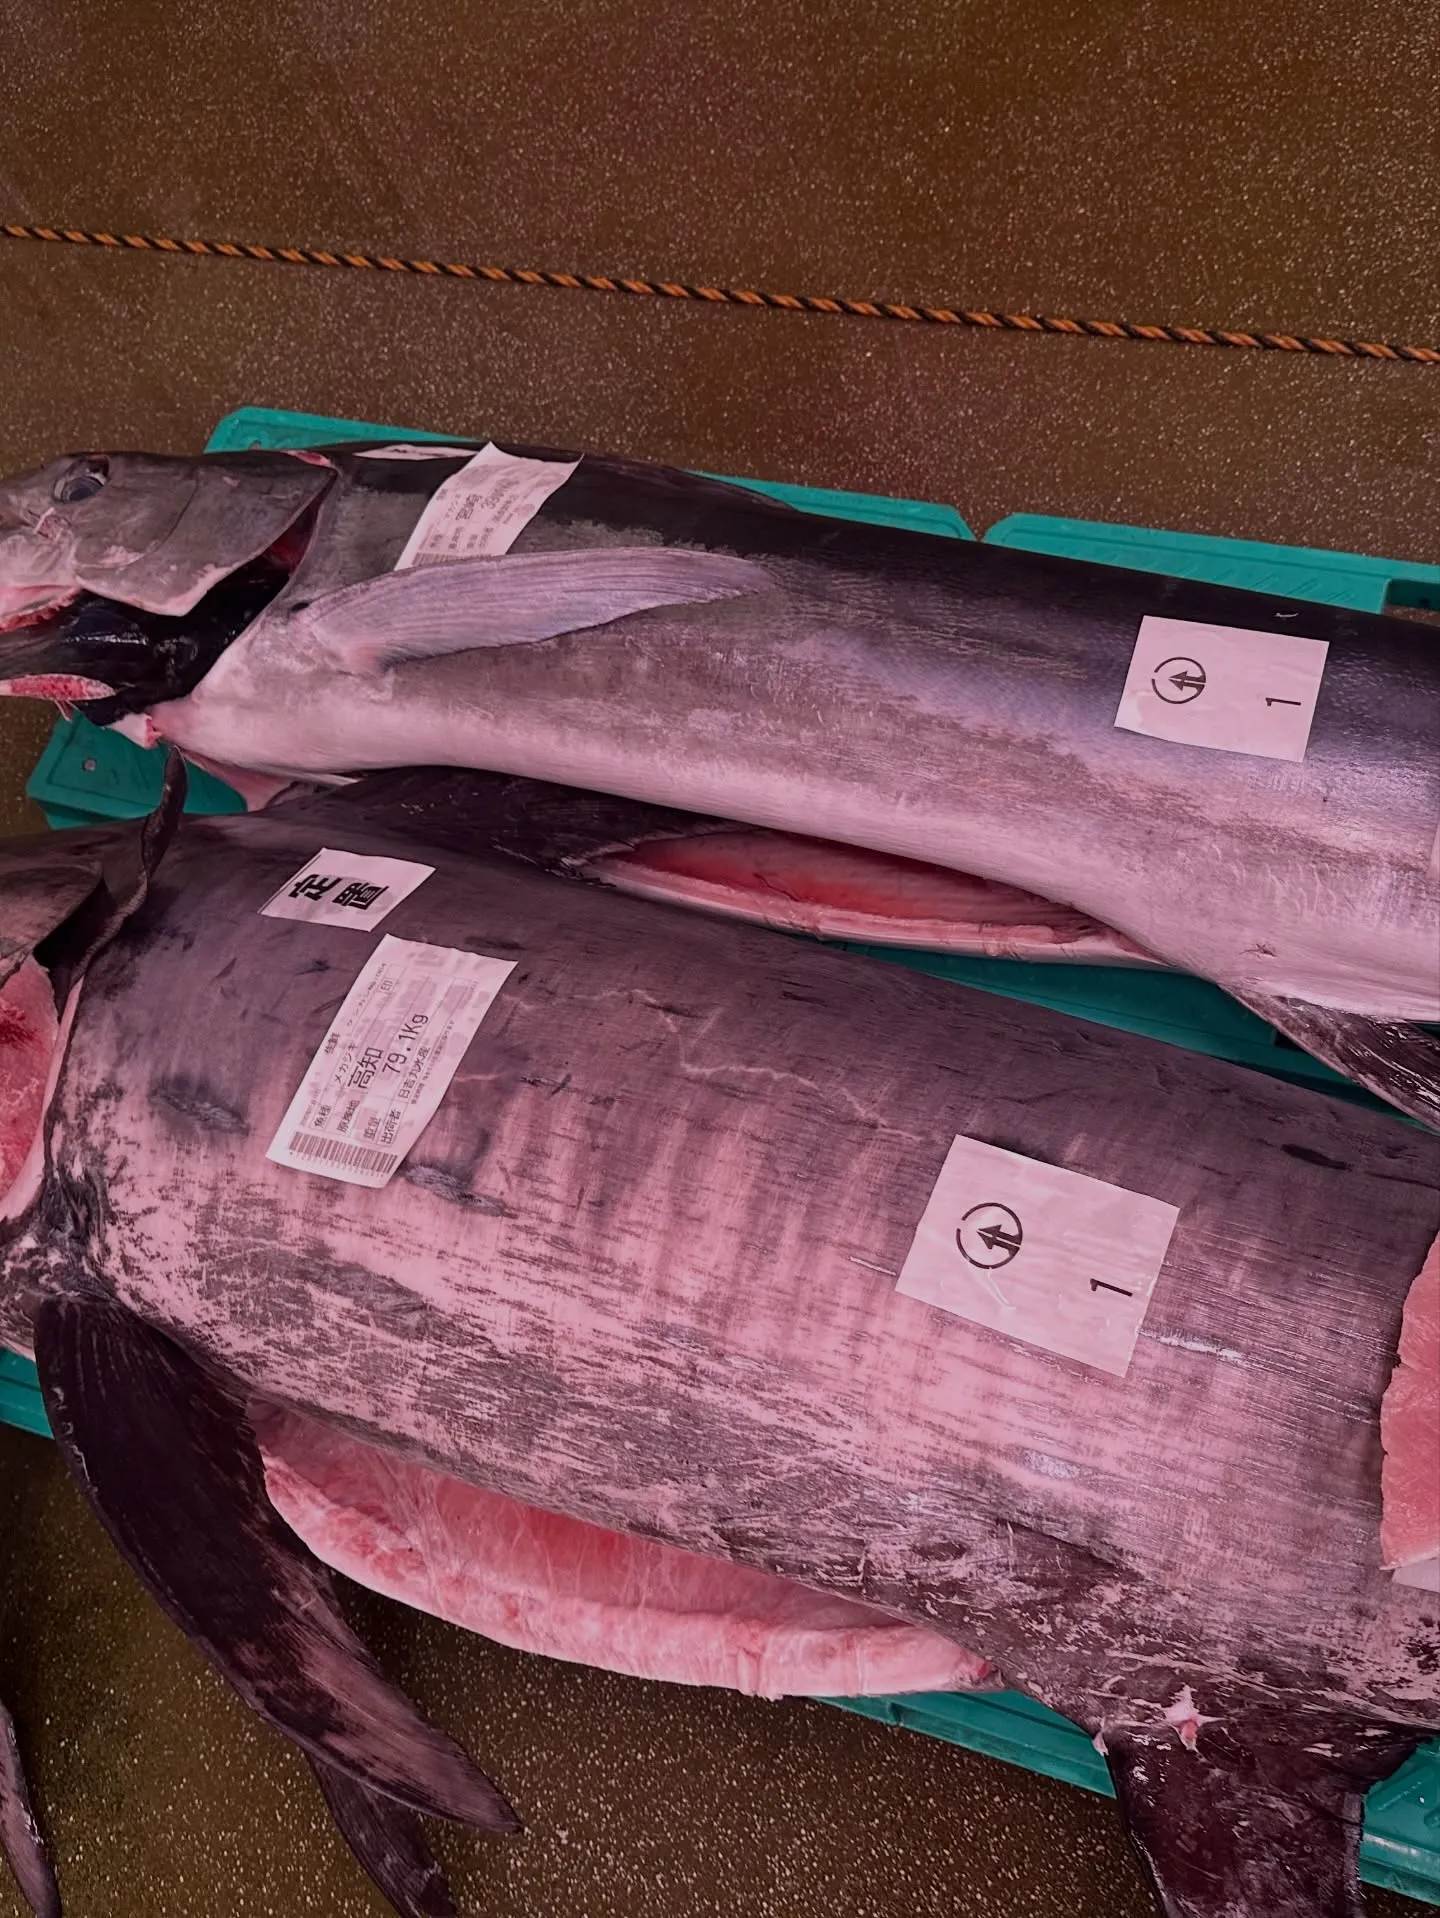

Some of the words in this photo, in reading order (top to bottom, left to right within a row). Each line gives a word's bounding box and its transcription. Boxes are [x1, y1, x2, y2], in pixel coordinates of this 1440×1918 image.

[1265, 697, 1302, 707] 1
[288, 873, 390, 911] 定置
[382, 1013, 429, 1075] 79.1Kg
[347, 1046, 383, 1089] 高知
[397, 1045, 430, 1099] 日吉丸水産
[380, 1108, 402, 1145] 出荷者
[1090, 1278, 1133, 1298] 1
